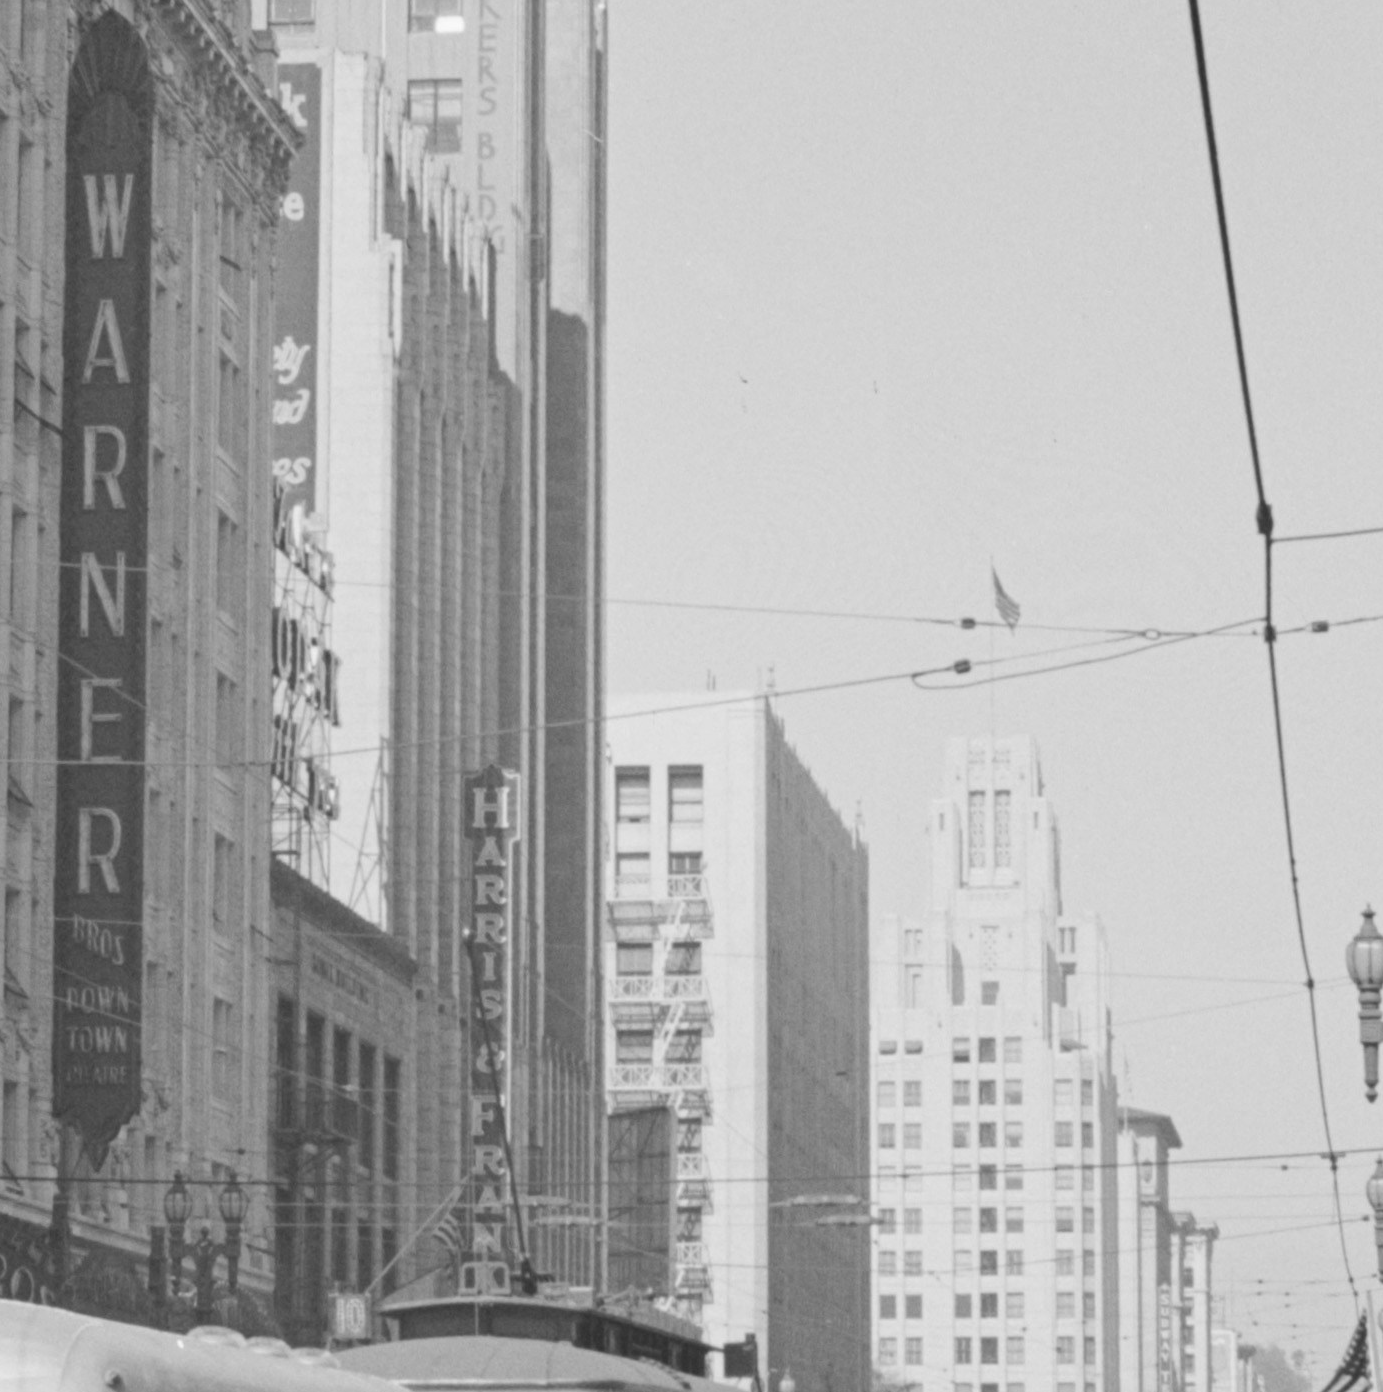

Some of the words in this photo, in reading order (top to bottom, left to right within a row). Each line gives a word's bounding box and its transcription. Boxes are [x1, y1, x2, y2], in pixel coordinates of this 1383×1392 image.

[75, 173, 135, 895] WARNER
[472, 787, 508, 1018] HARRIS
[73, 913, 125, 966] BROS
[67, 1025, 128, 1053] TOWN
[335, 1297, 366, 1335] 10
